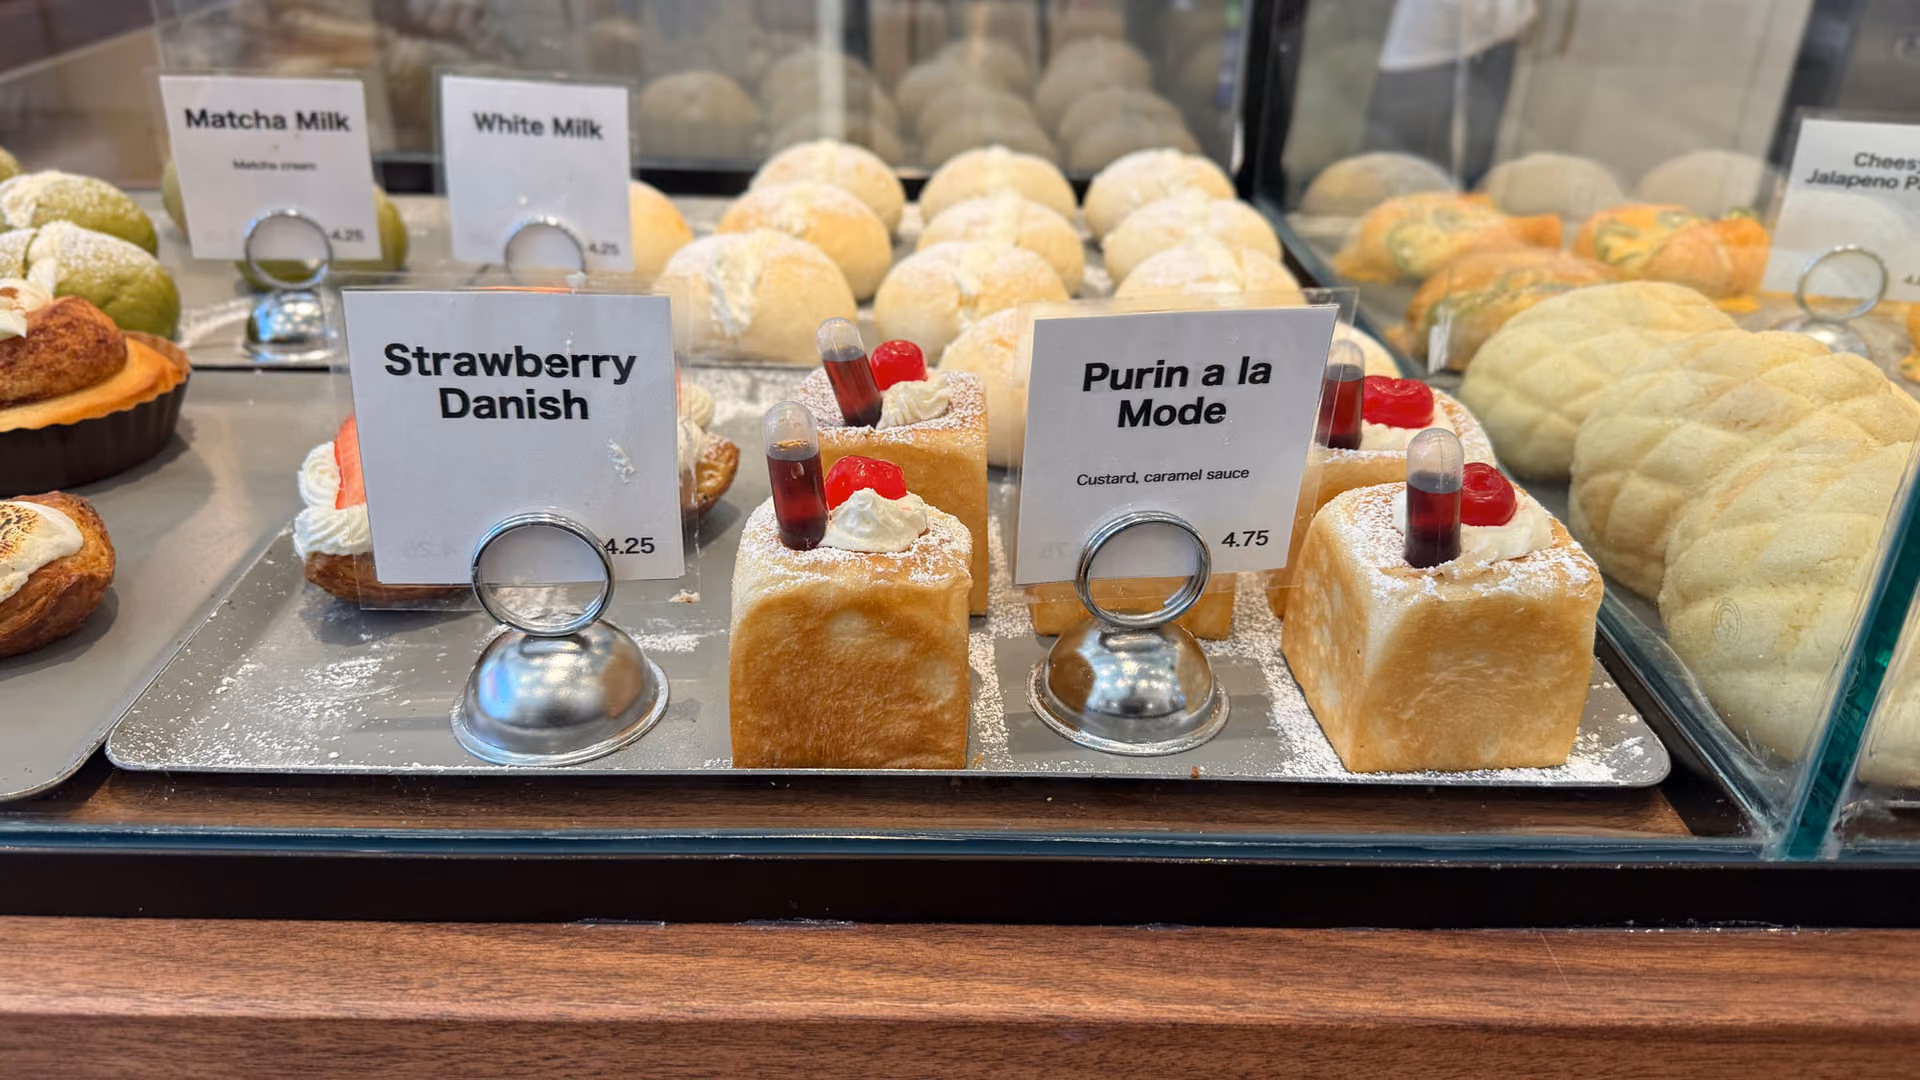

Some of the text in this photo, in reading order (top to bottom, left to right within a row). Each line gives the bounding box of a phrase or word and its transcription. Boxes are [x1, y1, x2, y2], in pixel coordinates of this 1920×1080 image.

[184, 108, 352, 132] Matcha Milk
[472, 112, 603, 140] White Milk
[232, 159, 318, 172] Matcha cream
[1805, 169, 1899, 189] Jalapeno
[384, 342, 637, 385] Strawberry
[1082, 356, 1273, 392] Purin a la
[438, 387, 589, 420] Danish
[1117, 397, 1227, 428] Mode
[1076, 467, 1250, 487] Custard, caramel sauce
[603, 537, 655, 555] 4.25
[1221, 530, 1270, 549] 4.75
